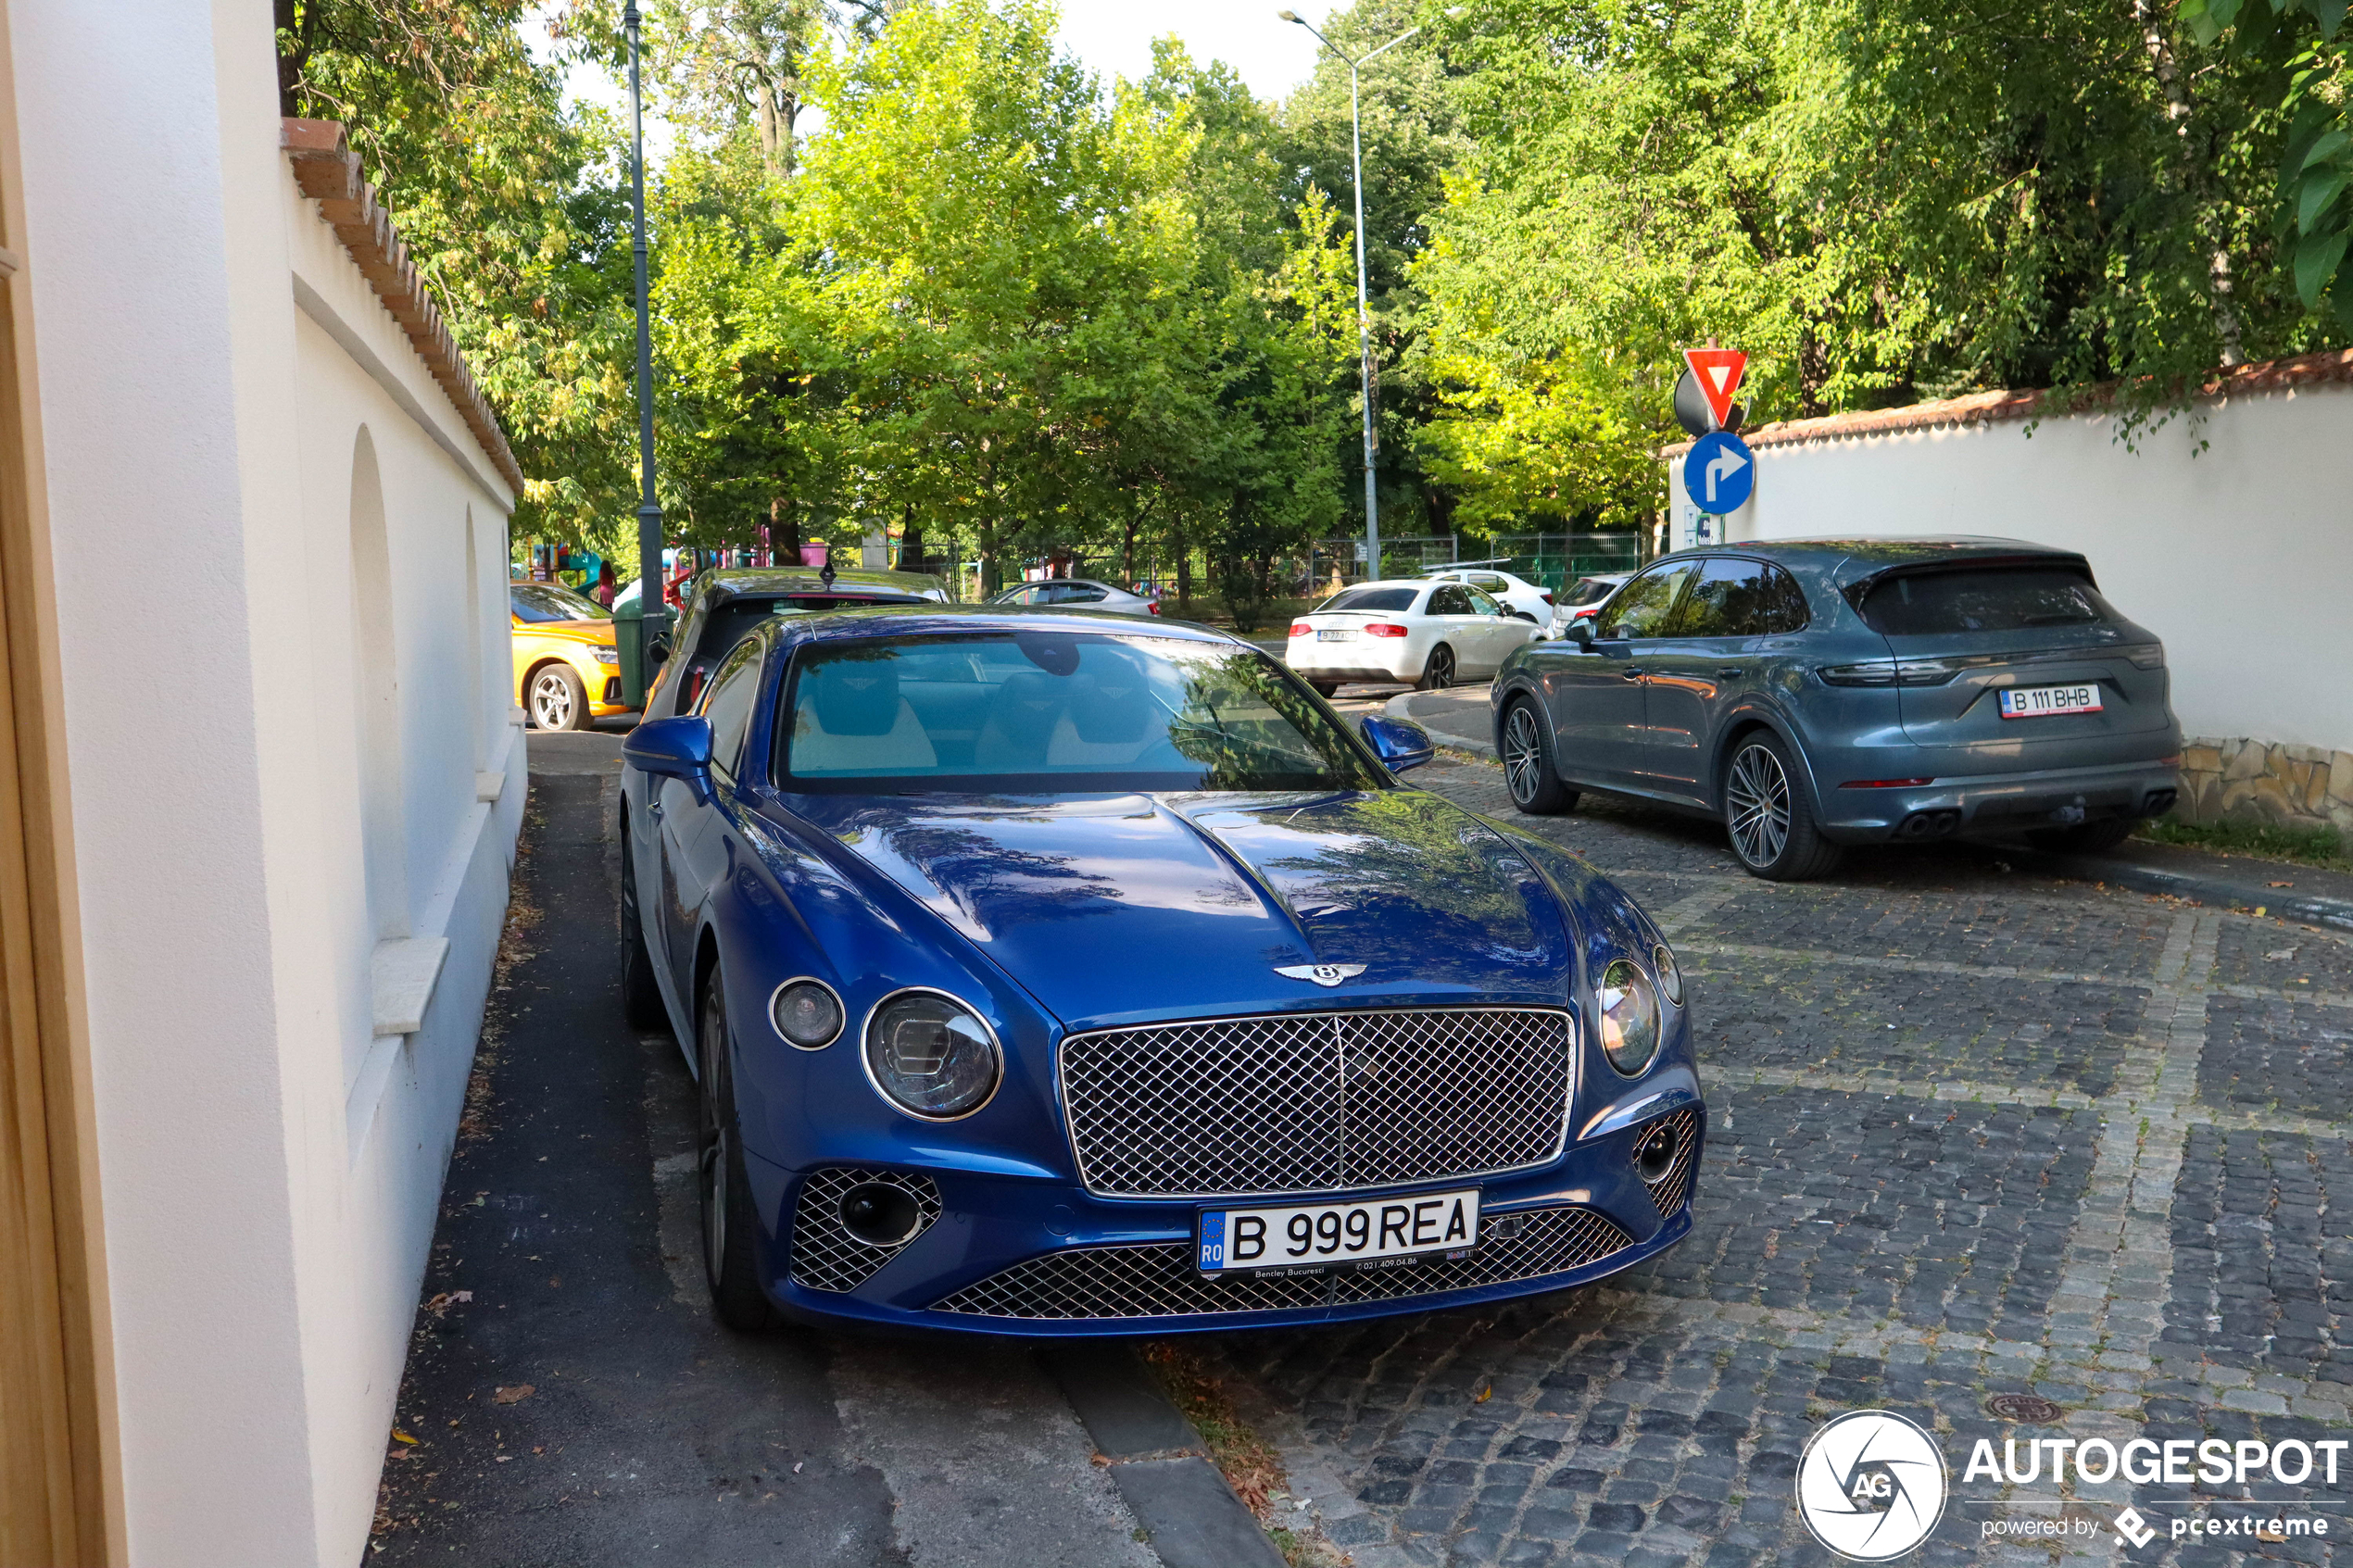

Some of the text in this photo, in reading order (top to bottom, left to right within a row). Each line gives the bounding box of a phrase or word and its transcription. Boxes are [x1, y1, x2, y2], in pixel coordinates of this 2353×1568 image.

[2014, 688, 2090, 710] B 111 BHB
[1233, 1198, 1466, 1261] B 999 REA
[1202, 1244, 1223, 1262] RO
[1255, 1266, 1325, 1278] Bentley Bucuresti
[1364, 1257, 1417, 1270] 021.409.04.86
